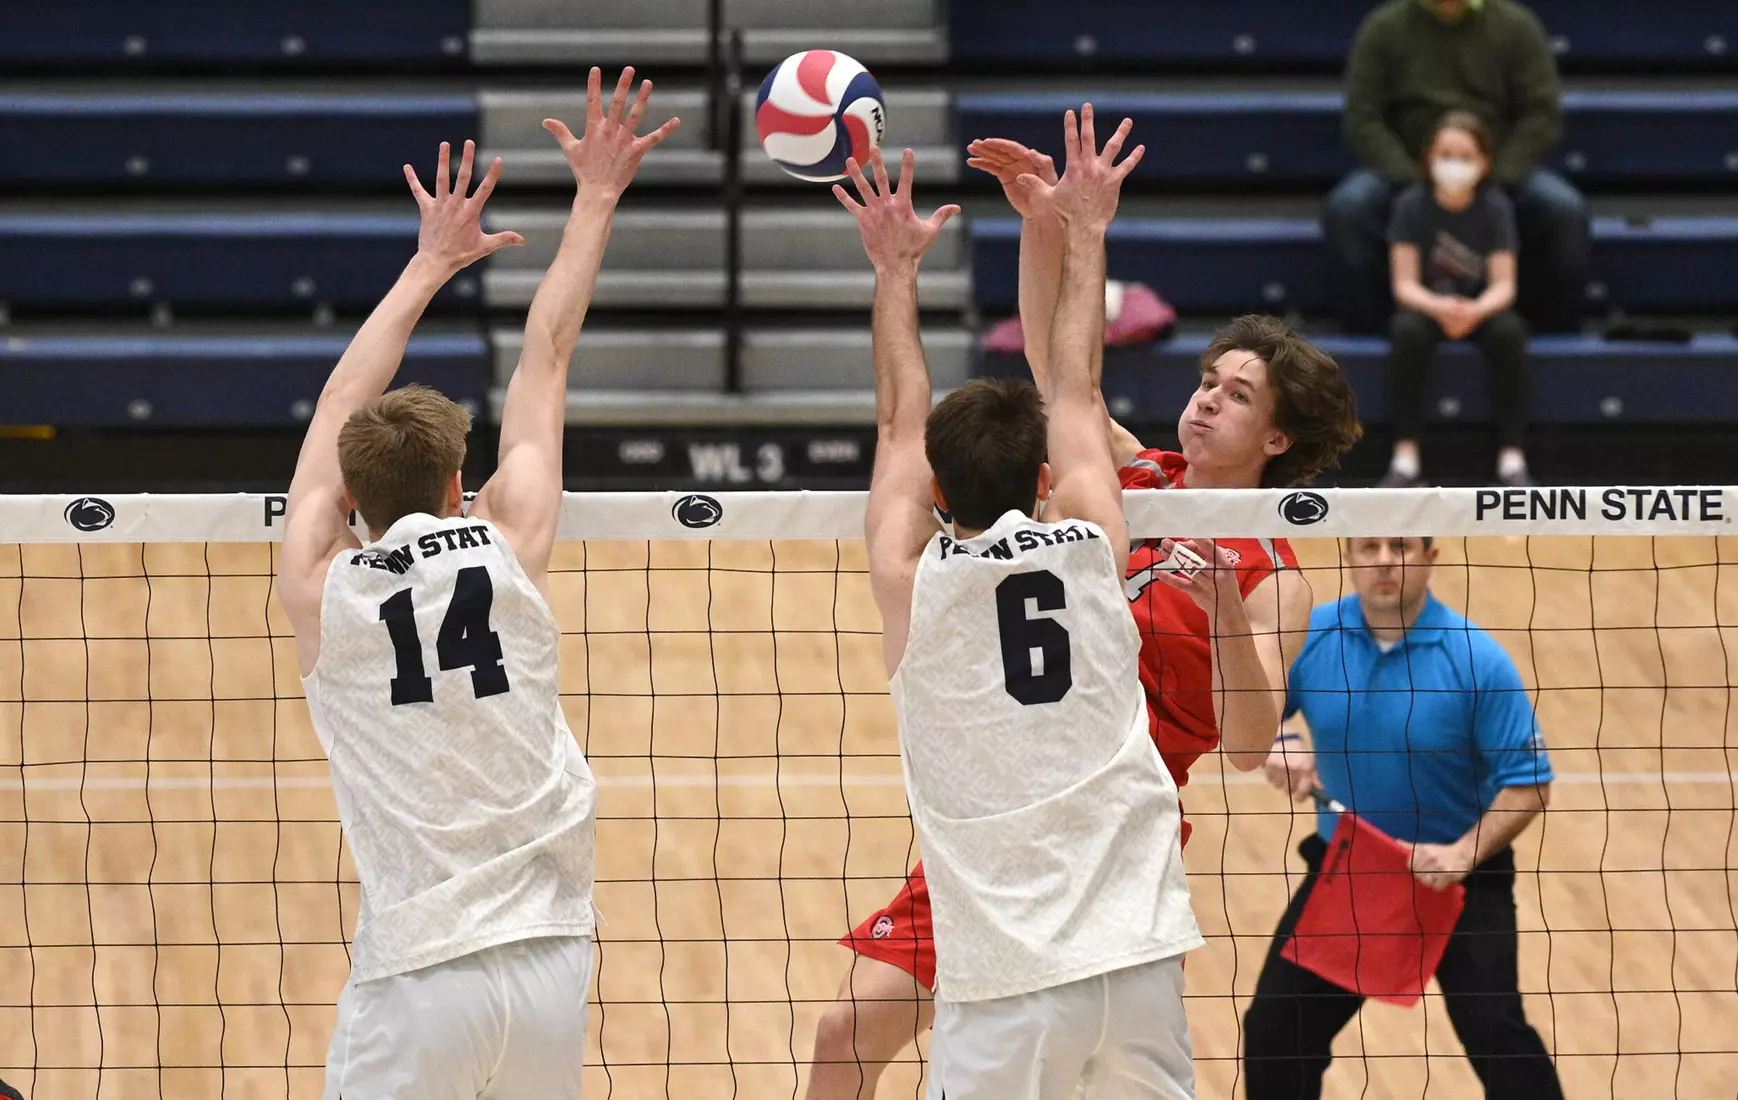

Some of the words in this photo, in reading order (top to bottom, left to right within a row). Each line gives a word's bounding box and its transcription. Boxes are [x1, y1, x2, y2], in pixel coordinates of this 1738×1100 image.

[688, 442, 752, 483] WL
[757, 442, 785, 483] 3
[1475, 489, 1586, 521] PENN
[1601, 489, 1723, 522] STATE
[379, 565, 510, 706] 14
[995, 569, 1073, 706] 6
